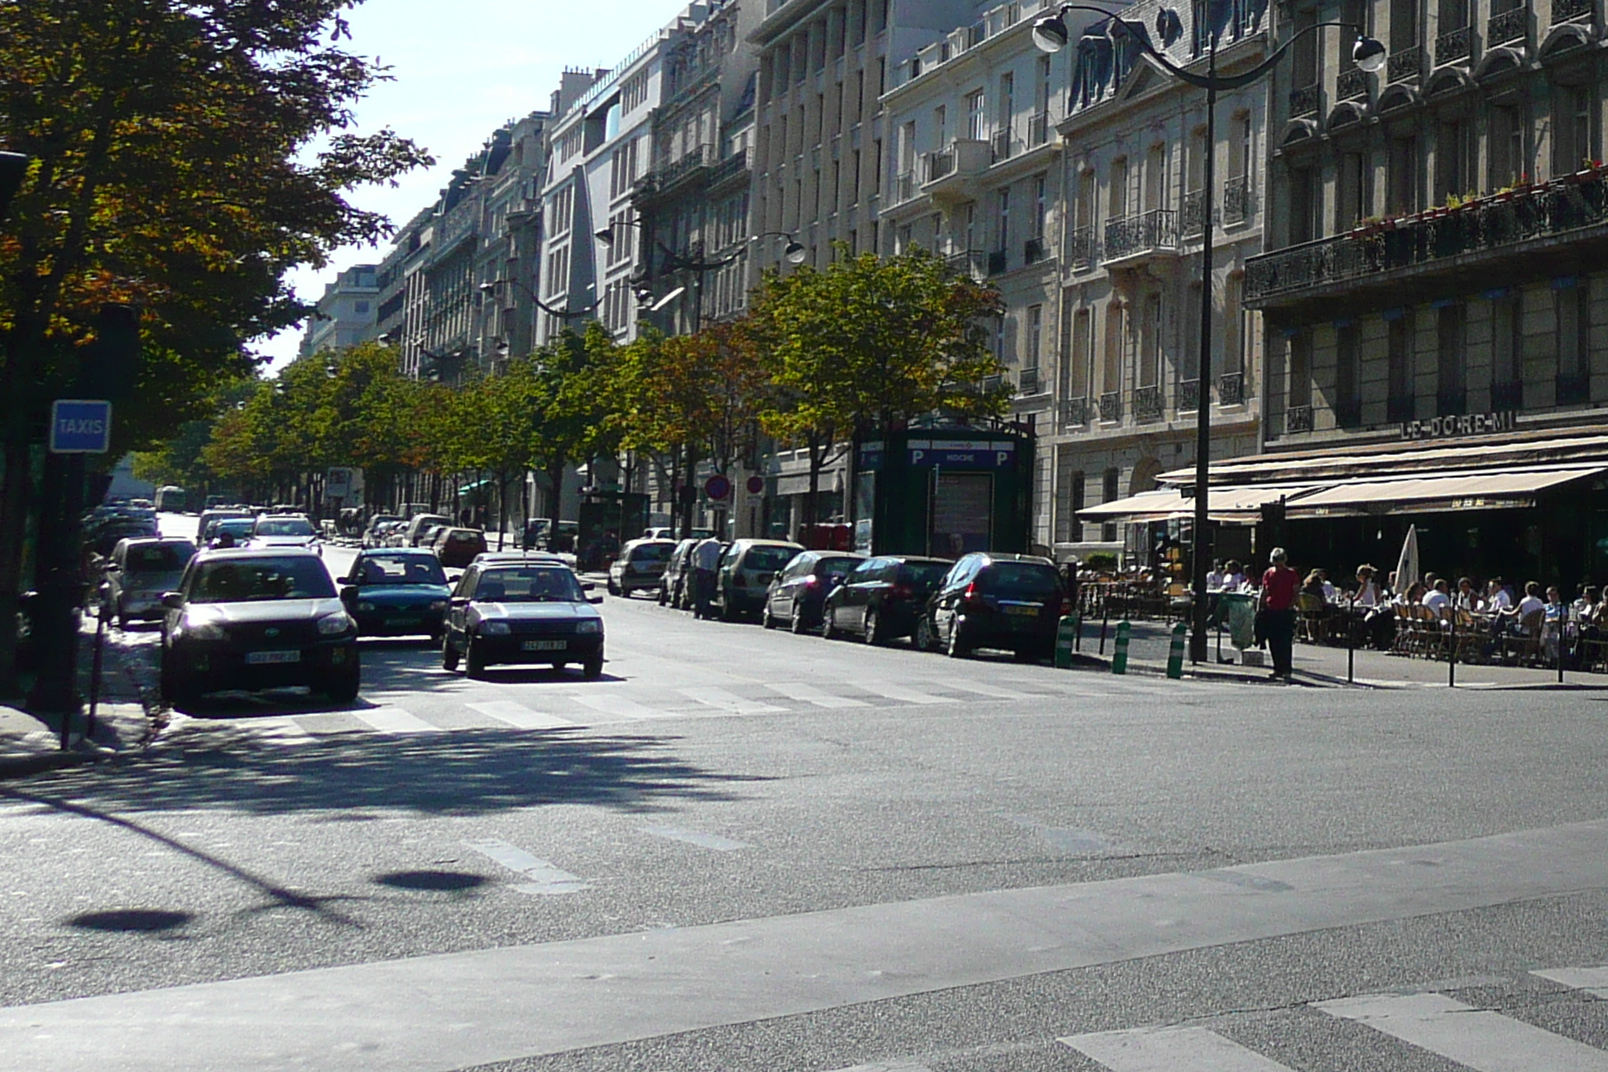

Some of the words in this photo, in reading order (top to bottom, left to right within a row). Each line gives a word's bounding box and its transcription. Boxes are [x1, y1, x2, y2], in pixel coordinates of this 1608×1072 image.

[60, 418, 103, 434] TAXIS
[911, 450, 925, 465] P
[996, 451, 1009, 467] P
